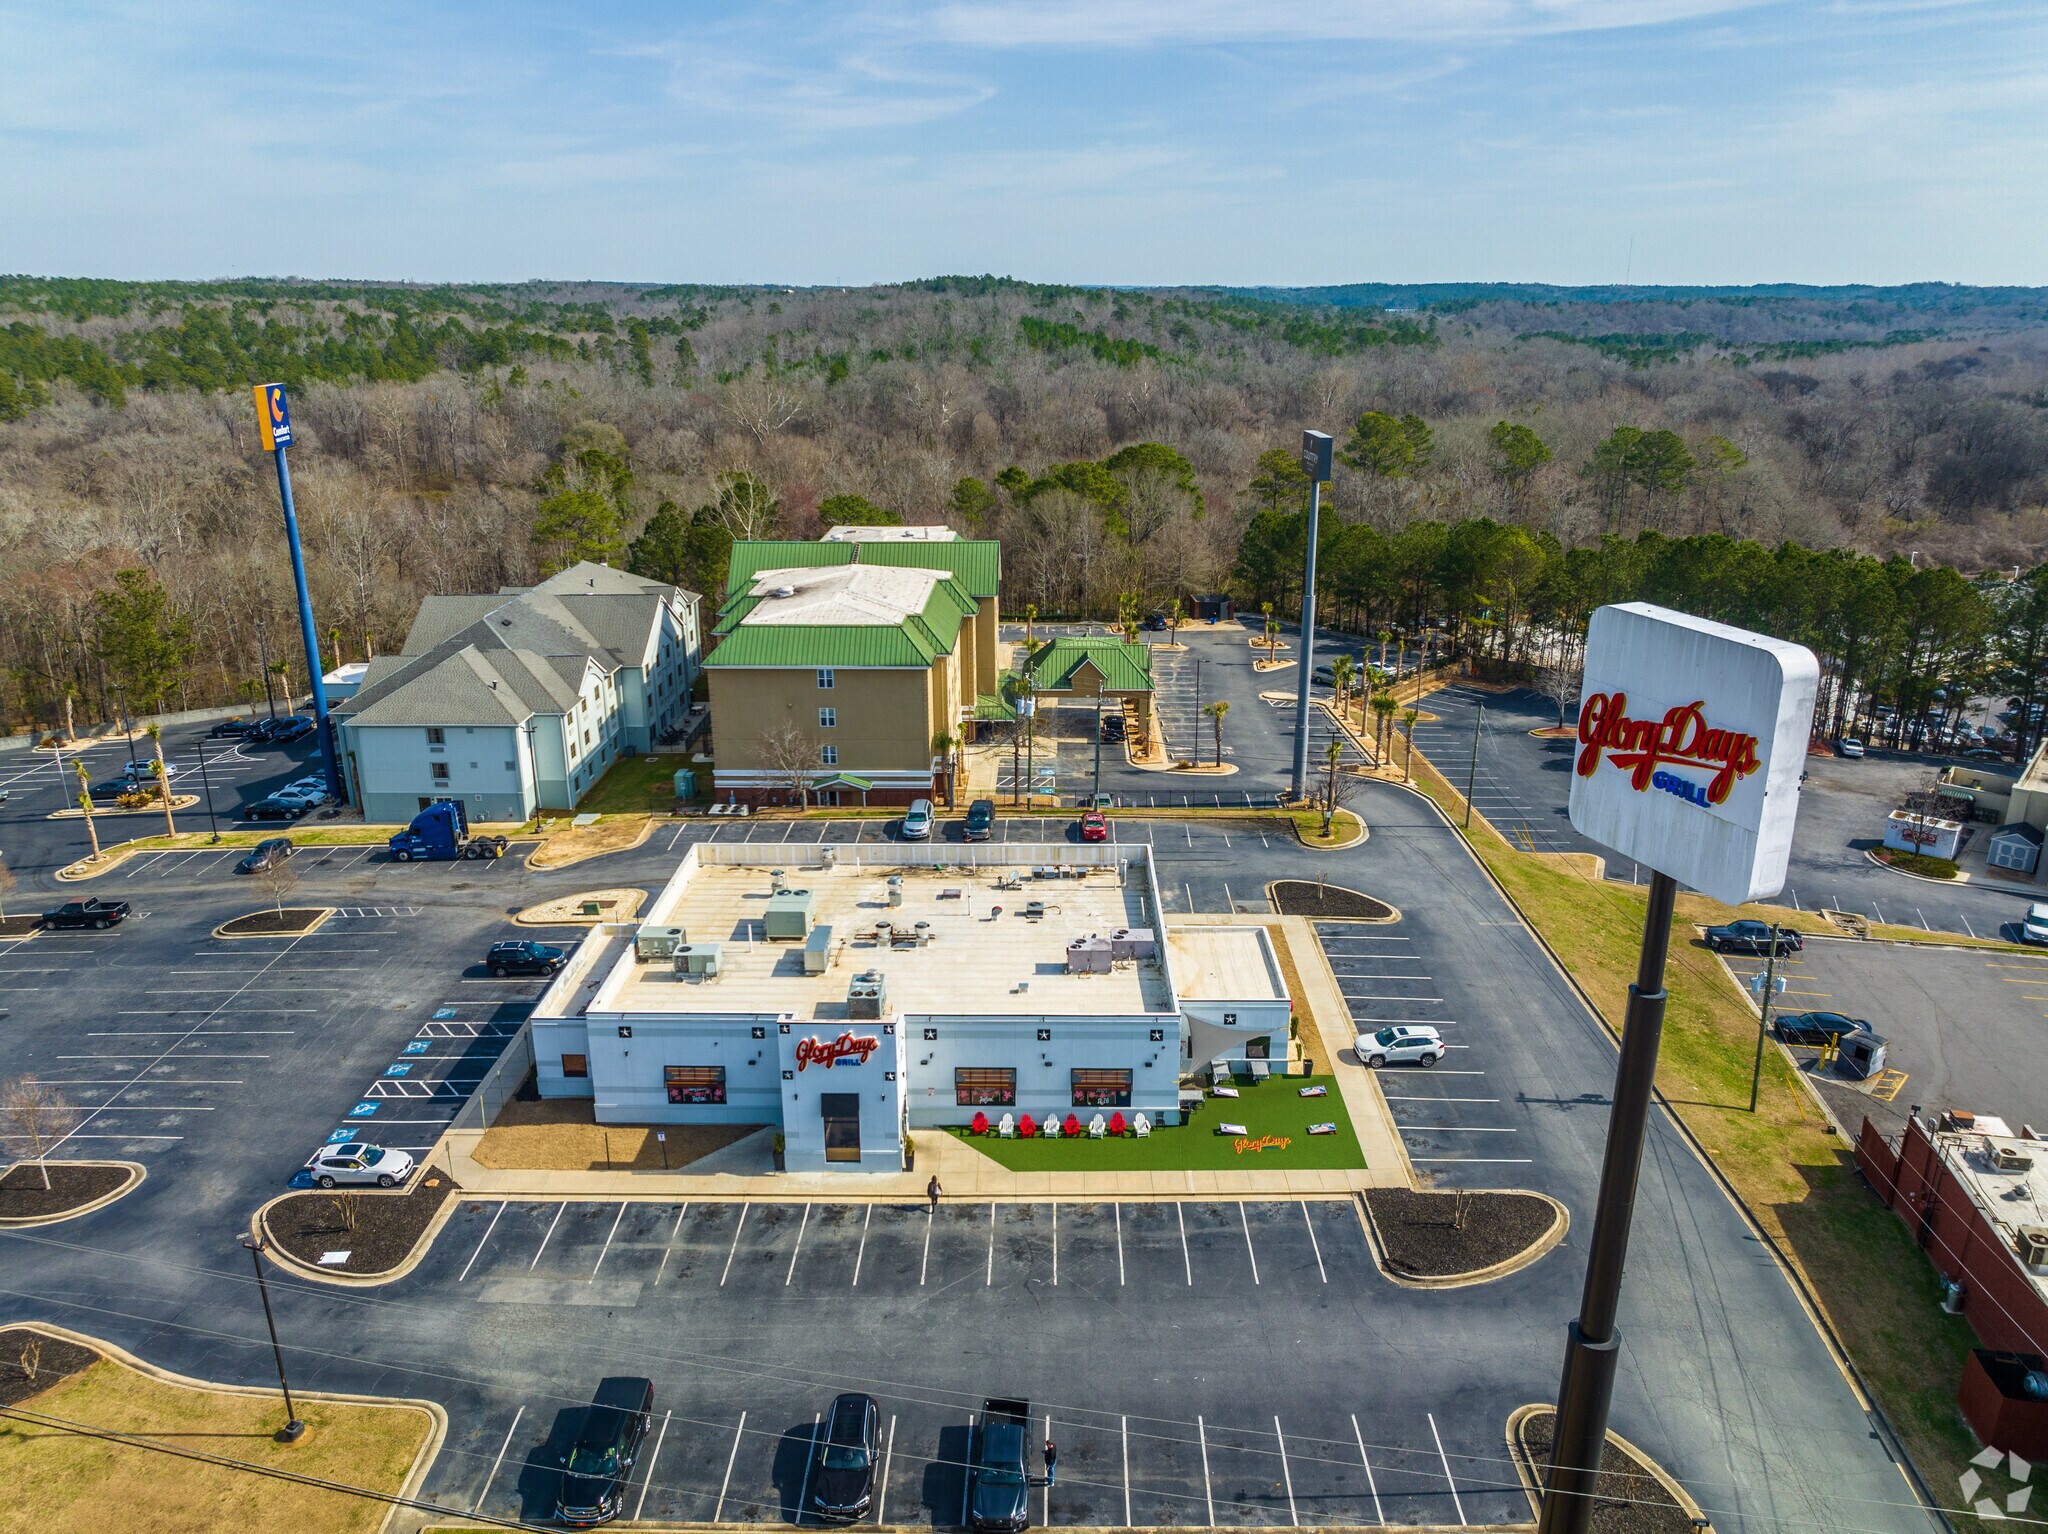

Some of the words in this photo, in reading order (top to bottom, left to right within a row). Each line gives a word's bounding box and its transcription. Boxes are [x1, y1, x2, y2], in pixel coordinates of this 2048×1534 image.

[1577, 692, 1666, 792] Glory
[1662, 700, 1761, 804] Days
[1652, 771, 1711, 808] GRILL
[796, 1036, 836, 1072] Glory
[833, 1030, 880, 1064] Days
[835, 1058, 861, 1066] GRILL
[1233, 1137, 1262, 1154] Glory
